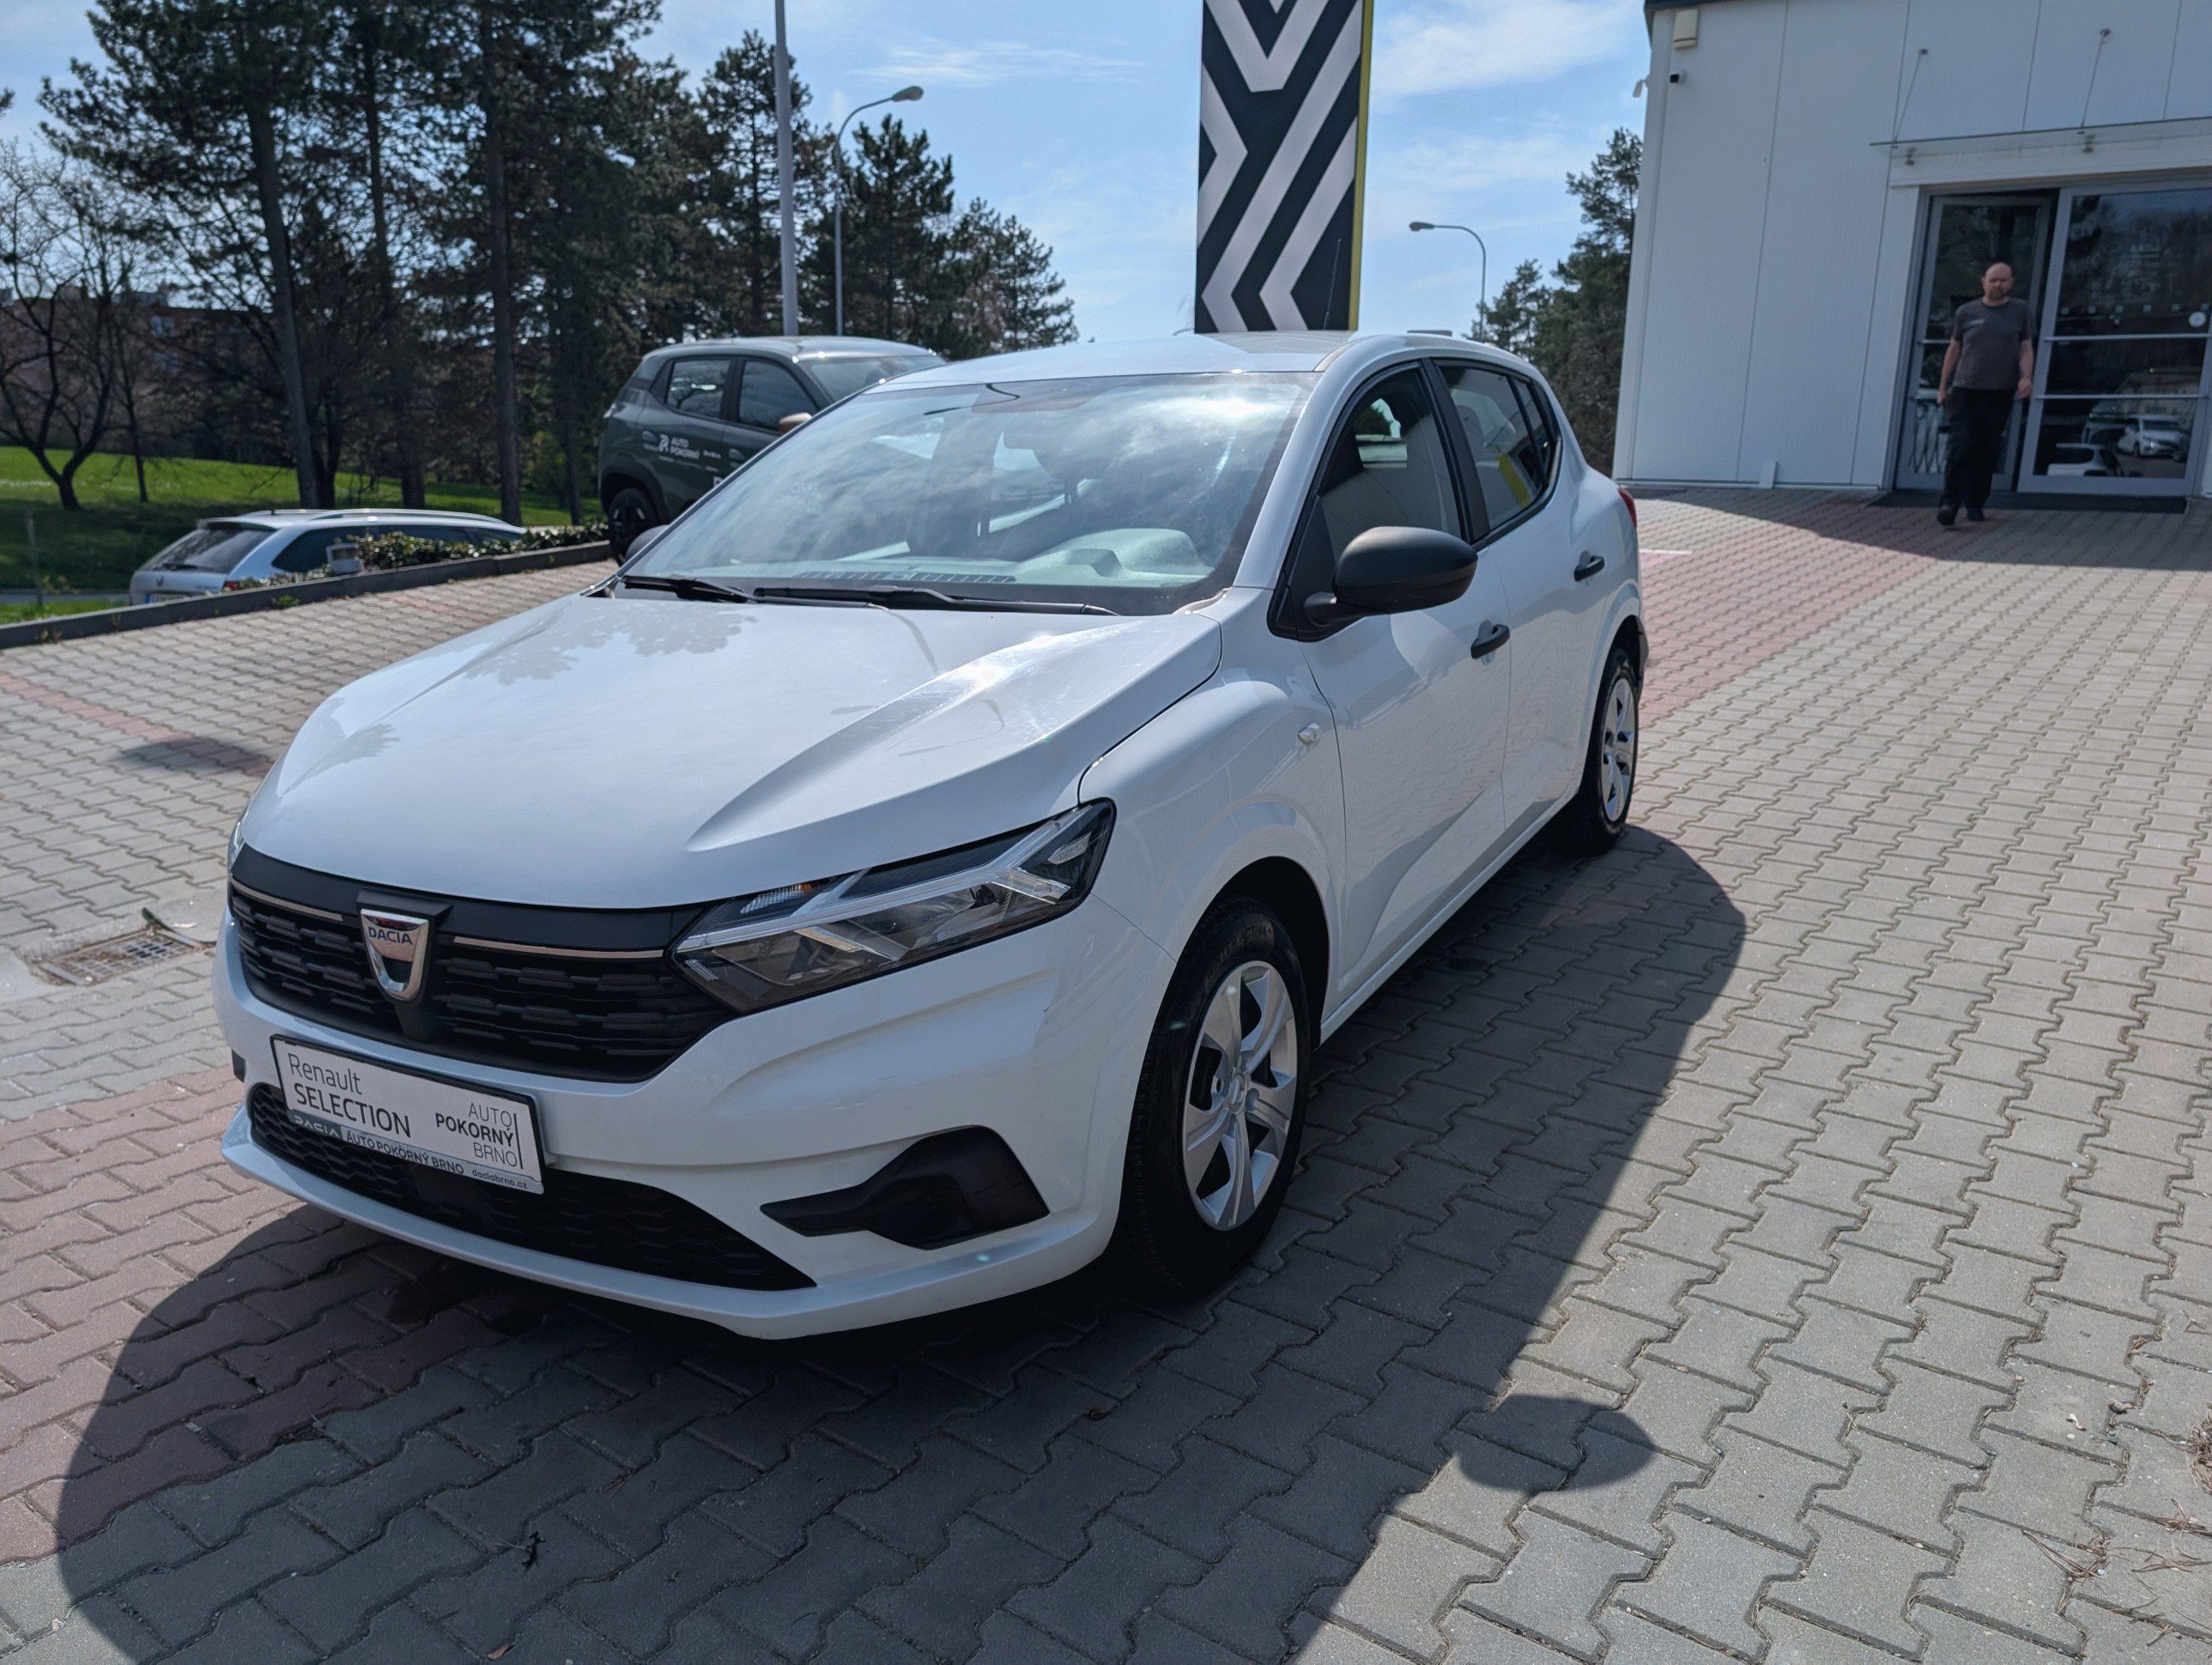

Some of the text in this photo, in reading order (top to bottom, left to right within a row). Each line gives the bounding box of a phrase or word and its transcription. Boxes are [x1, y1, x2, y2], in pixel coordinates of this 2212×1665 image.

[368, 926, 413, 945] DACIA
[288, 1052, 362, 1095] Renault
[294, 1082, 410, 1138] SELECTION
[469, 1102, 512, 1128] AUTO
[294, 1115, 340, 1138] DACIA
[435, 1112, 513, 1147] POKORNÝ
[347, 1130, 464, 1174] AUTO POKORNÝ BRNO
[473, 1141, 517, 1167] BRNO
